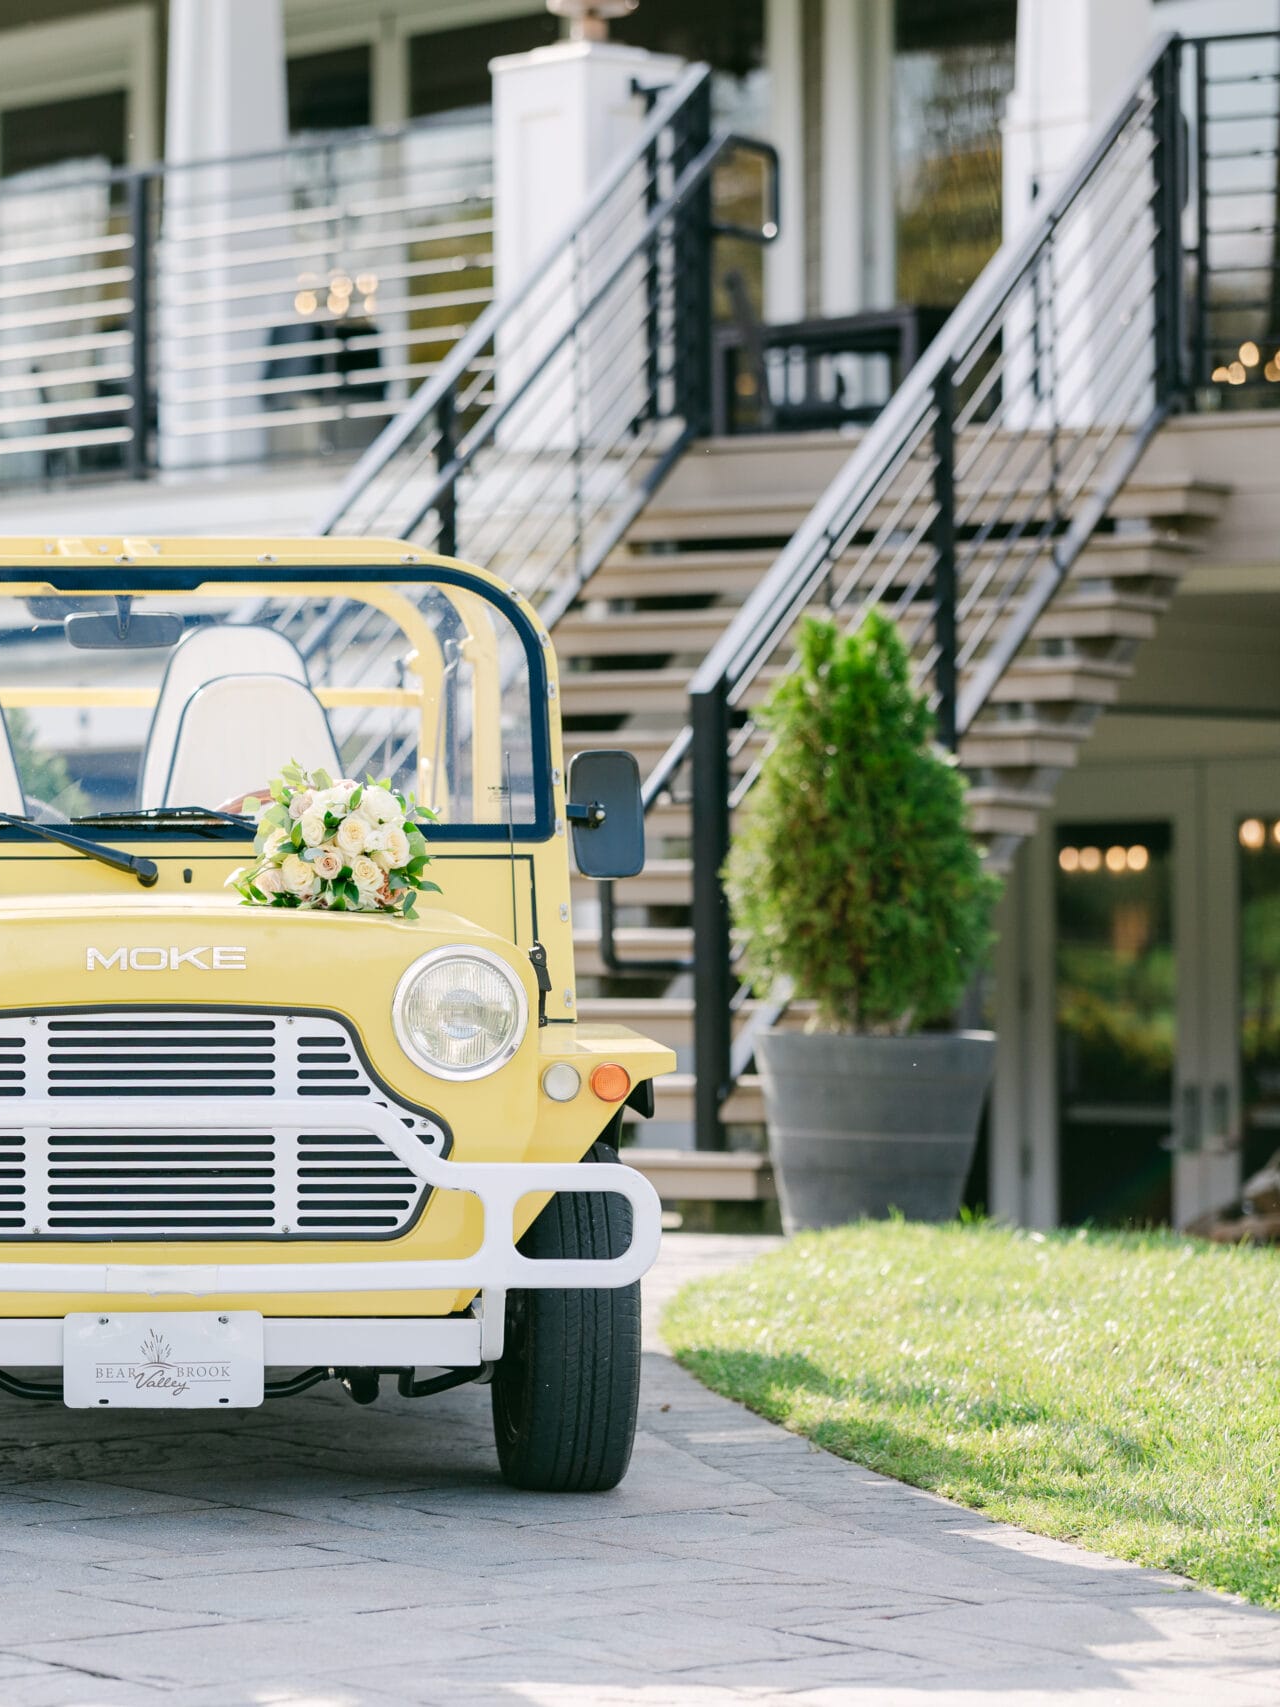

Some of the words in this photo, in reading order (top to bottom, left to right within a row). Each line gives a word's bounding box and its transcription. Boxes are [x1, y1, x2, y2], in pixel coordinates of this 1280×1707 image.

[86, 946, 247, 971] MOKE
[95, 1367, 136, 1379] BEAR
[176, 1366, 231, 1378] BROOK
[133, 1369, 190, 1396] Valley
